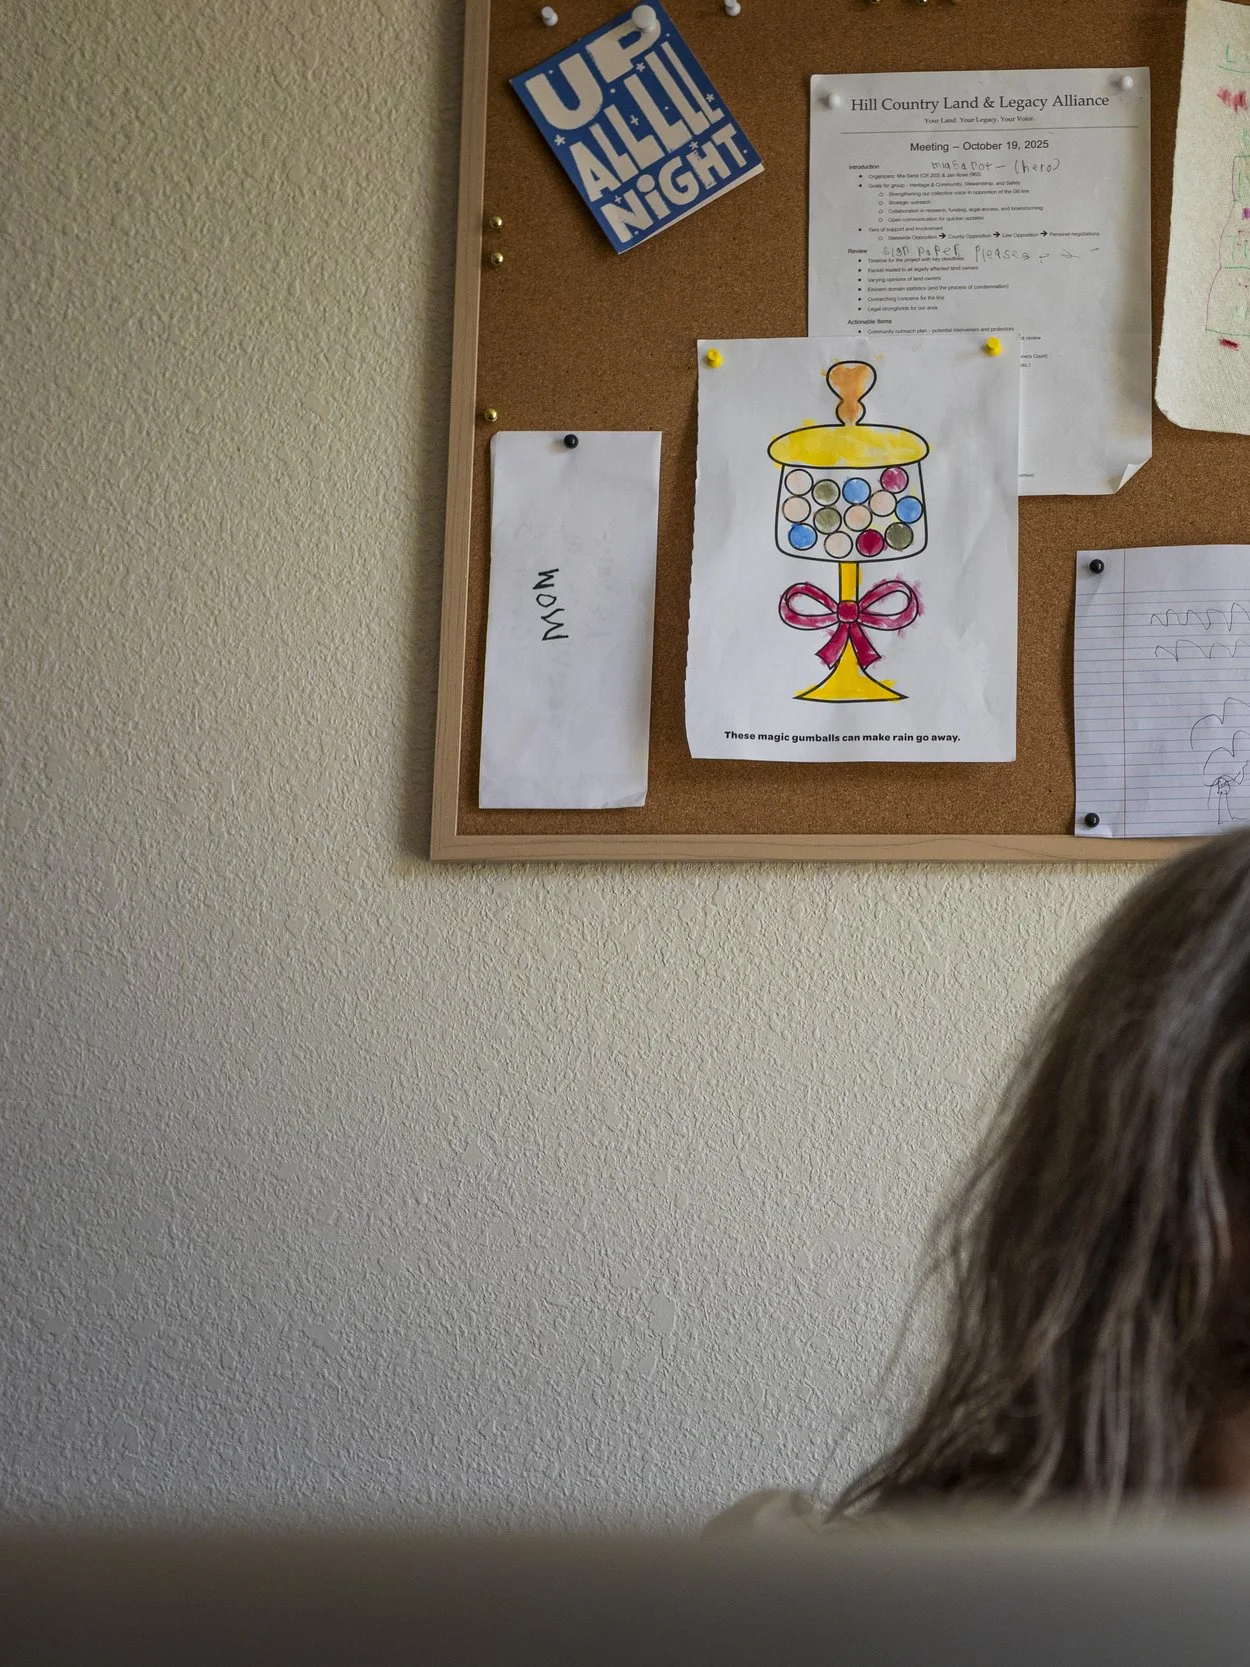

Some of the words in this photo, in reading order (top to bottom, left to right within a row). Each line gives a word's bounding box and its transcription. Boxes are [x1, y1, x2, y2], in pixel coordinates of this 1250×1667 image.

[524, 17, 662, 130] UP
[852, 98, 877, 111] Hill
[882, 98, 939, 113] Country
[944, 97, 978, 109] Land
[983, 97, 995, 108] &
[1000, 96, 1048, 111] Legacy
[1052, 95, 1110, 107] Alliance
[910, 143, 949, 152] Meeting
[963, 142, 1002, 150] October
[1006, 141, 1020, 150] 19,
[1025, 140, 1049, 149] 2025
[883, 246, 909, 257] sign
[724, 731, 756, 740] These
[758, 733, 790, 742] magic
[792, 733, 840, 743] gumballs
[862, 733, 890, 741] make
[893, 733, 914, 741] rain
[916, 734, 929, 743] go
